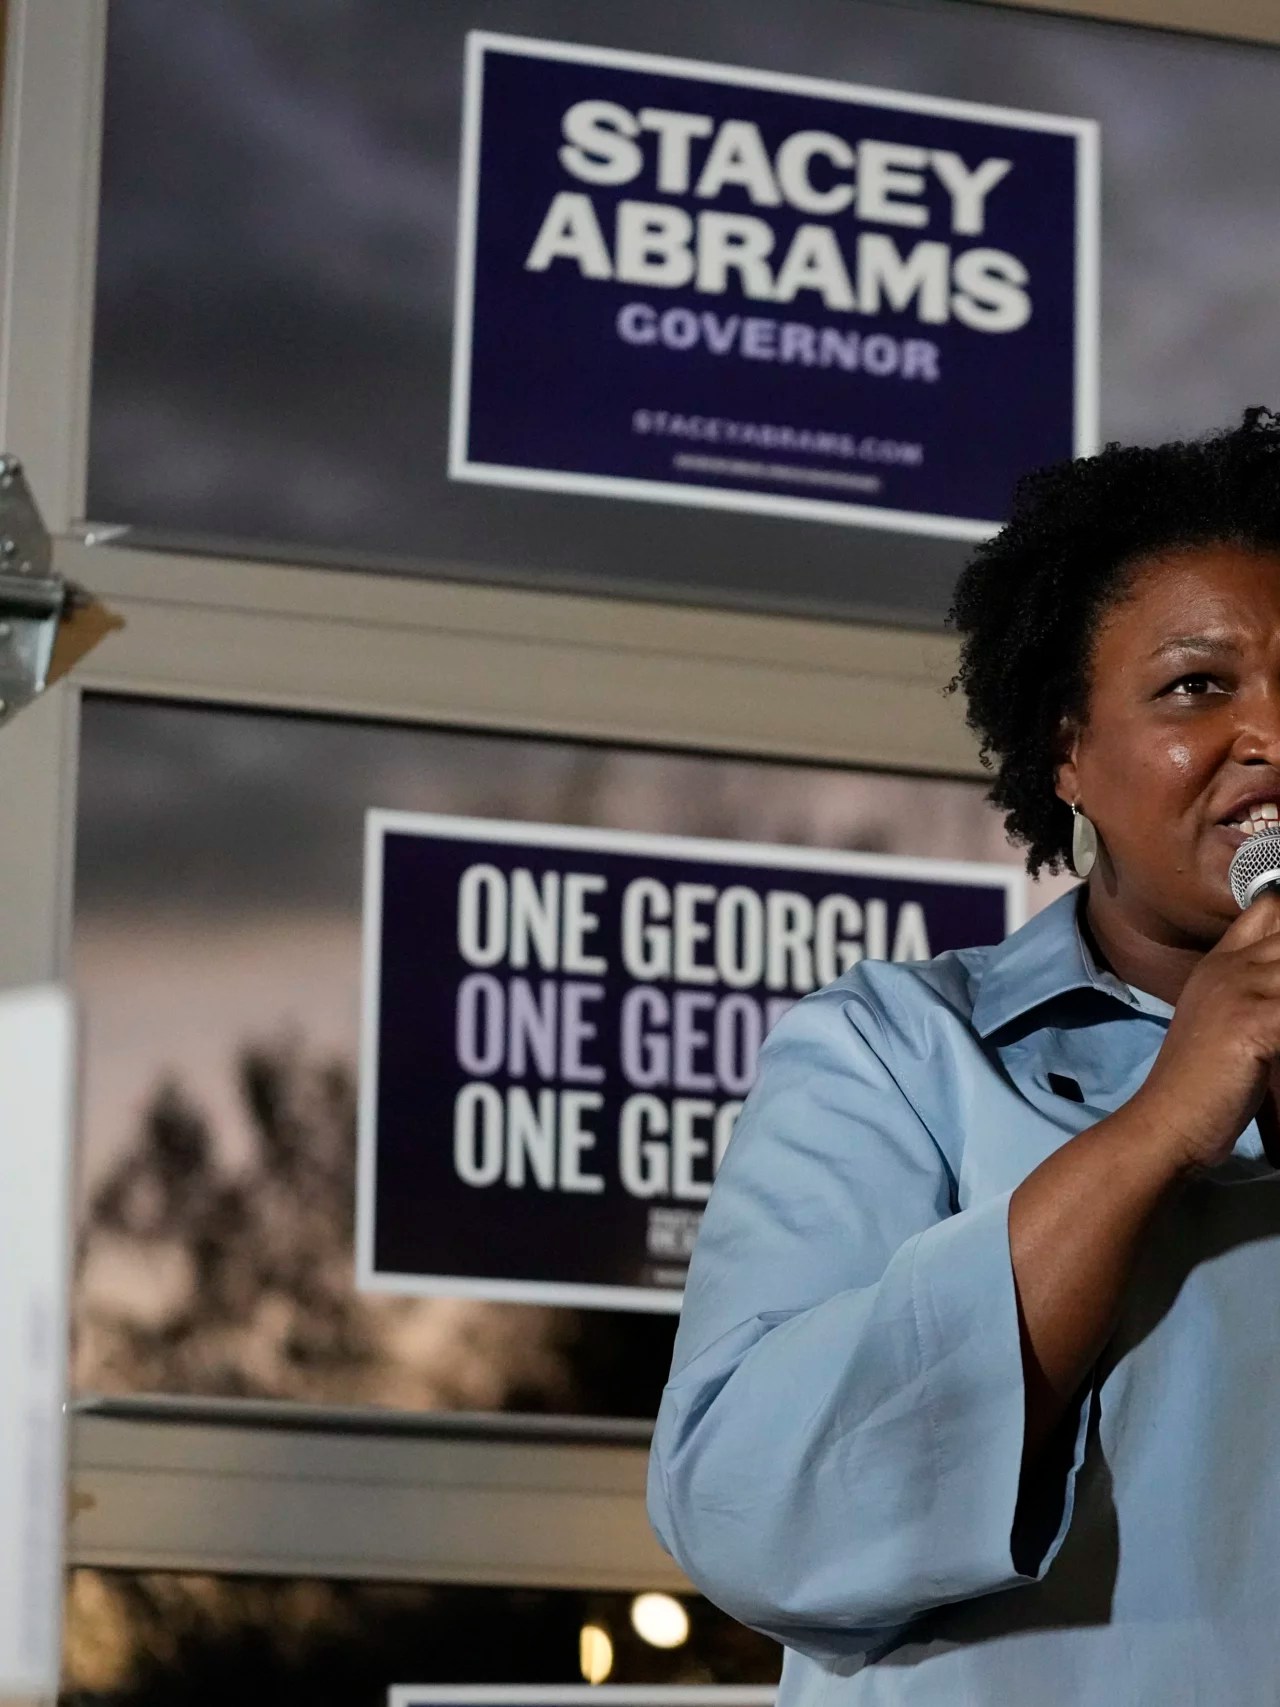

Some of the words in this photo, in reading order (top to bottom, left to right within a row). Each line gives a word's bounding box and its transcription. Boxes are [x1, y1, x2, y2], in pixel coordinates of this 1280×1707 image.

[558, 100, 1014, 237] STACEY
[525, 191, 1032, 334] ABRAMS
[617, 303, 941, 383] GOVERNOR
[632, 408, 924, 467] STACEYABRAMS.COM
[457, 863, 608, 978] ONE
[621, 877, 932, 993] GEORGIA
[455, 972, 605, 1084] ONE
[453, 1082, 605, 1194] ONE
